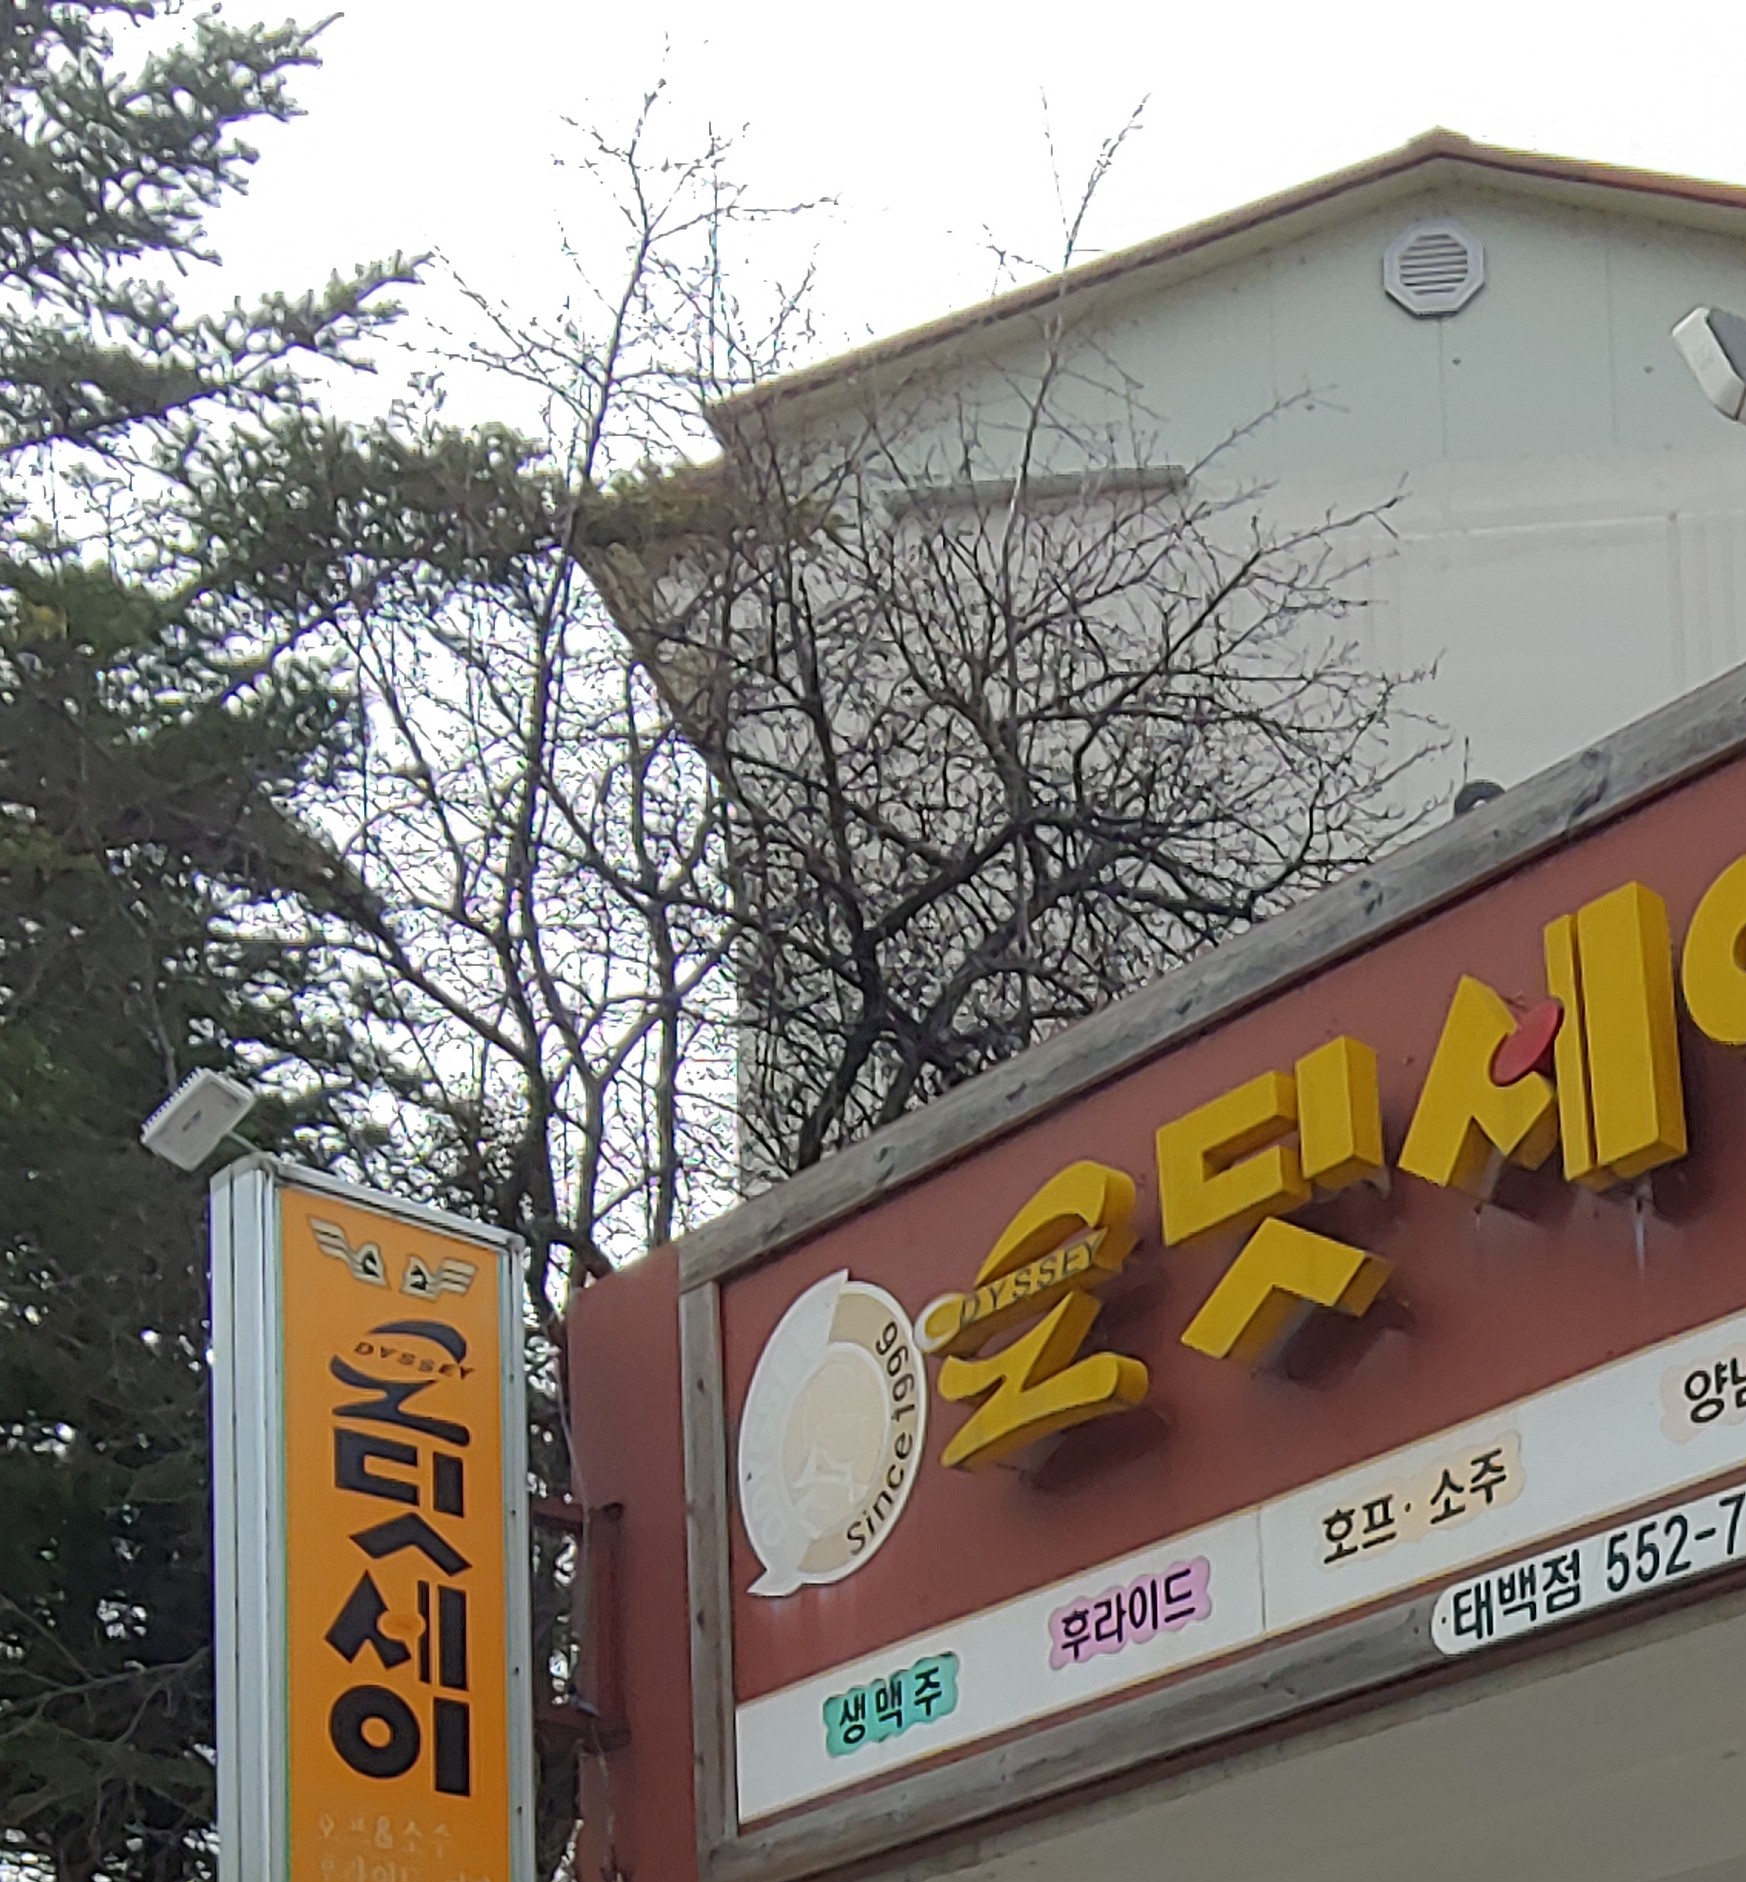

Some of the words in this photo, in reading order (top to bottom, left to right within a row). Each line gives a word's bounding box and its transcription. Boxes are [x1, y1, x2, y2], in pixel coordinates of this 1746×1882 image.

[875, 1321, 915, 1423] 1996
[837, 1667, 942, 1744] 생맥주
[1062, 1569, 1195, 1660] 후라이드
[1430, 1448, 1509, 1527] 소주
[1451, 1553, 1583, 1642] 태백점
